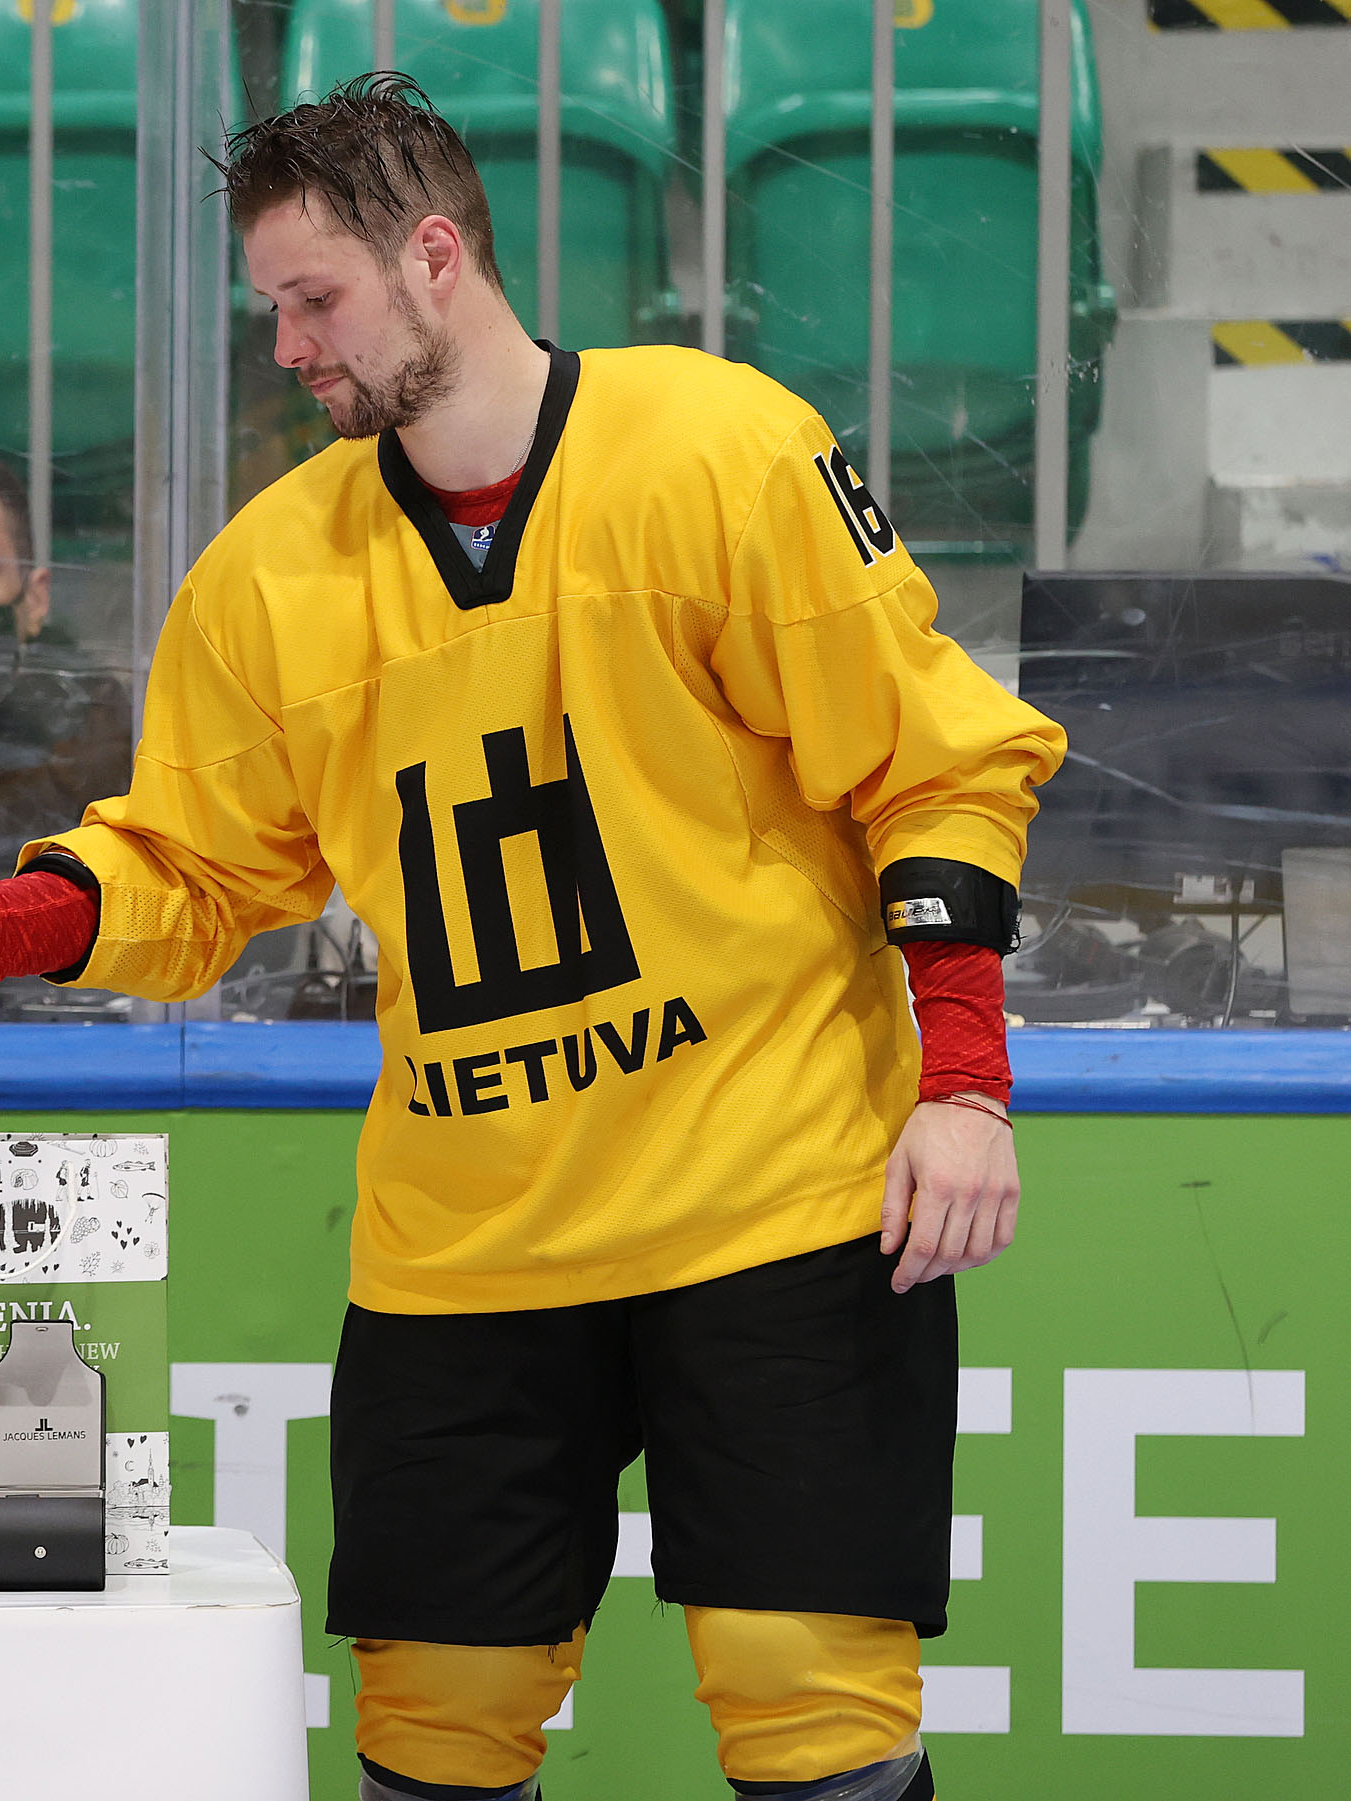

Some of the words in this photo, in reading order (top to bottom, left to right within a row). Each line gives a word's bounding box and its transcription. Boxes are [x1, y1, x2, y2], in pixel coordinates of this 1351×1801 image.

[811, 444, 897, 569] 16
[3, 1432, 45, 1442] JACQUES
[47, 1430, 87, 1441] LEMANS
